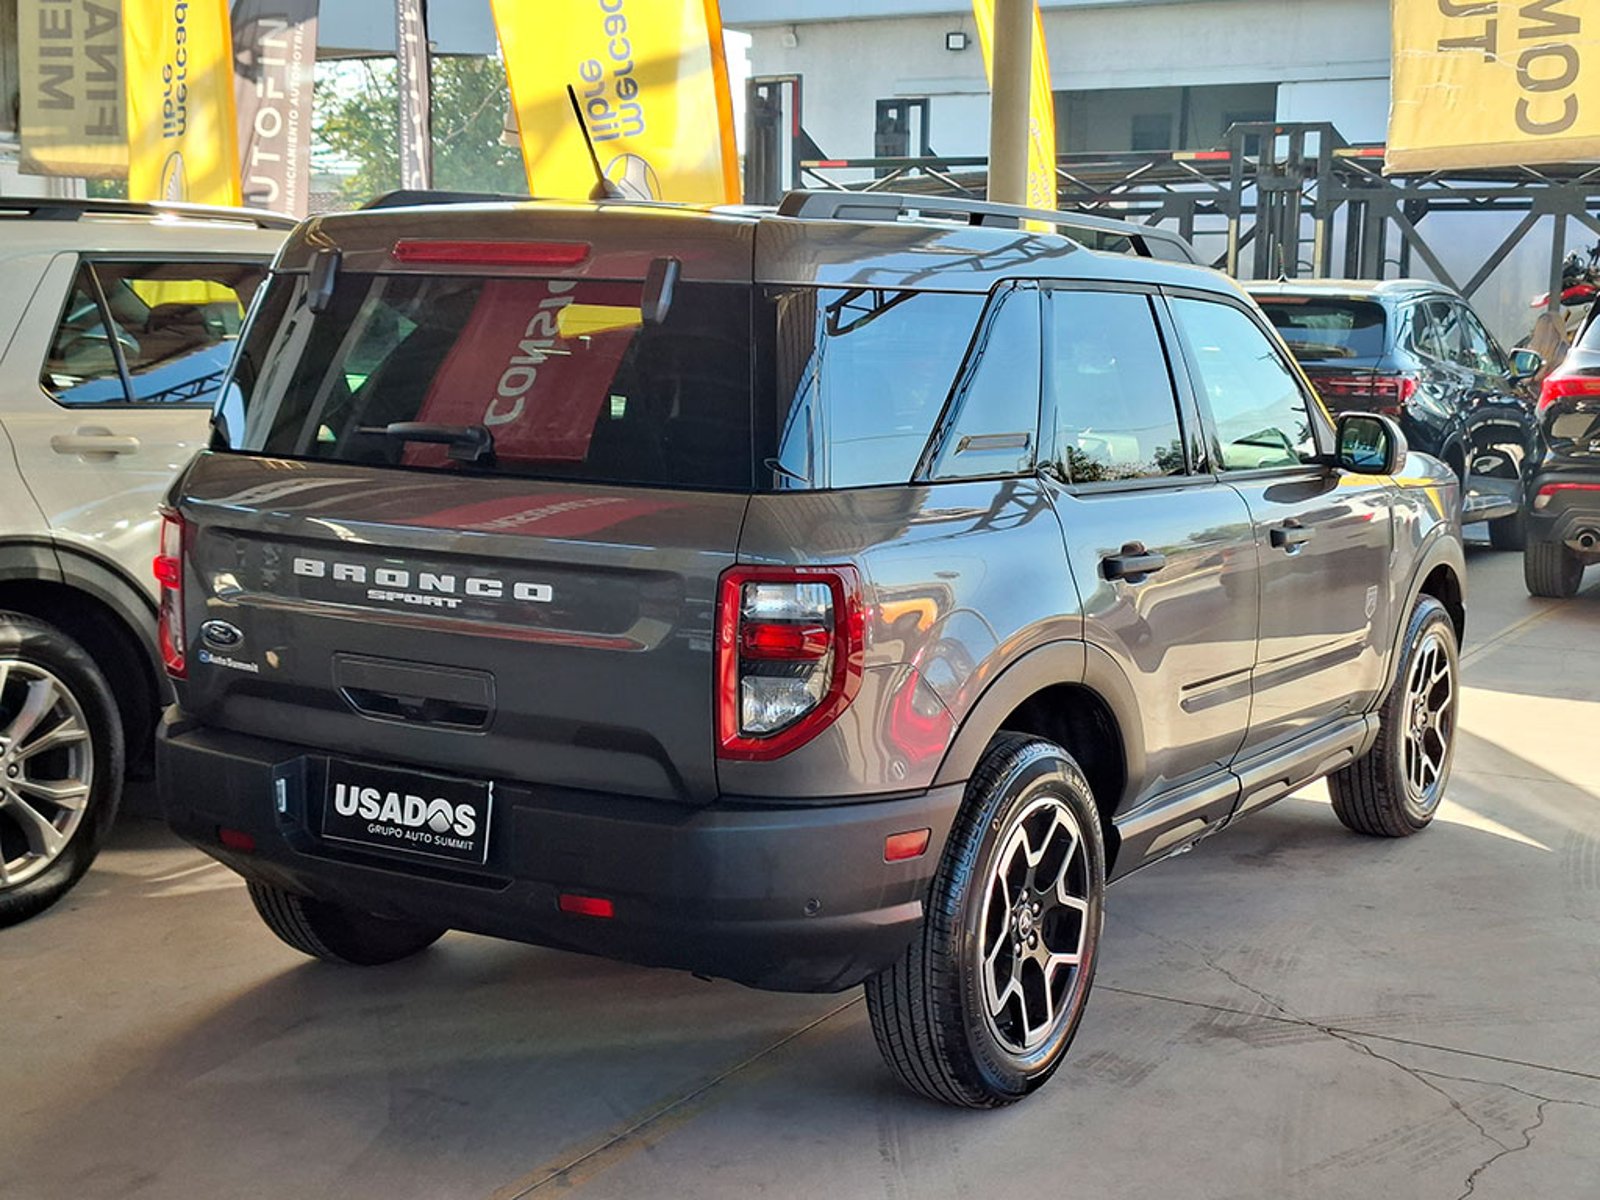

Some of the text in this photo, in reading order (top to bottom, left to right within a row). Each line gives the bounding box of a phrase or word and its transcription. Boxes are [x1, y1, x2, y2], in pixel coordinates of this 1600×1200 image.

[293, 557, 553, 603] BRONCO
[367, 589, 462, 609] SPORT
[334, 783, 477, 837] USADOS
[367, 823, 475, 851] GRUPO AUTO SUMMIT
